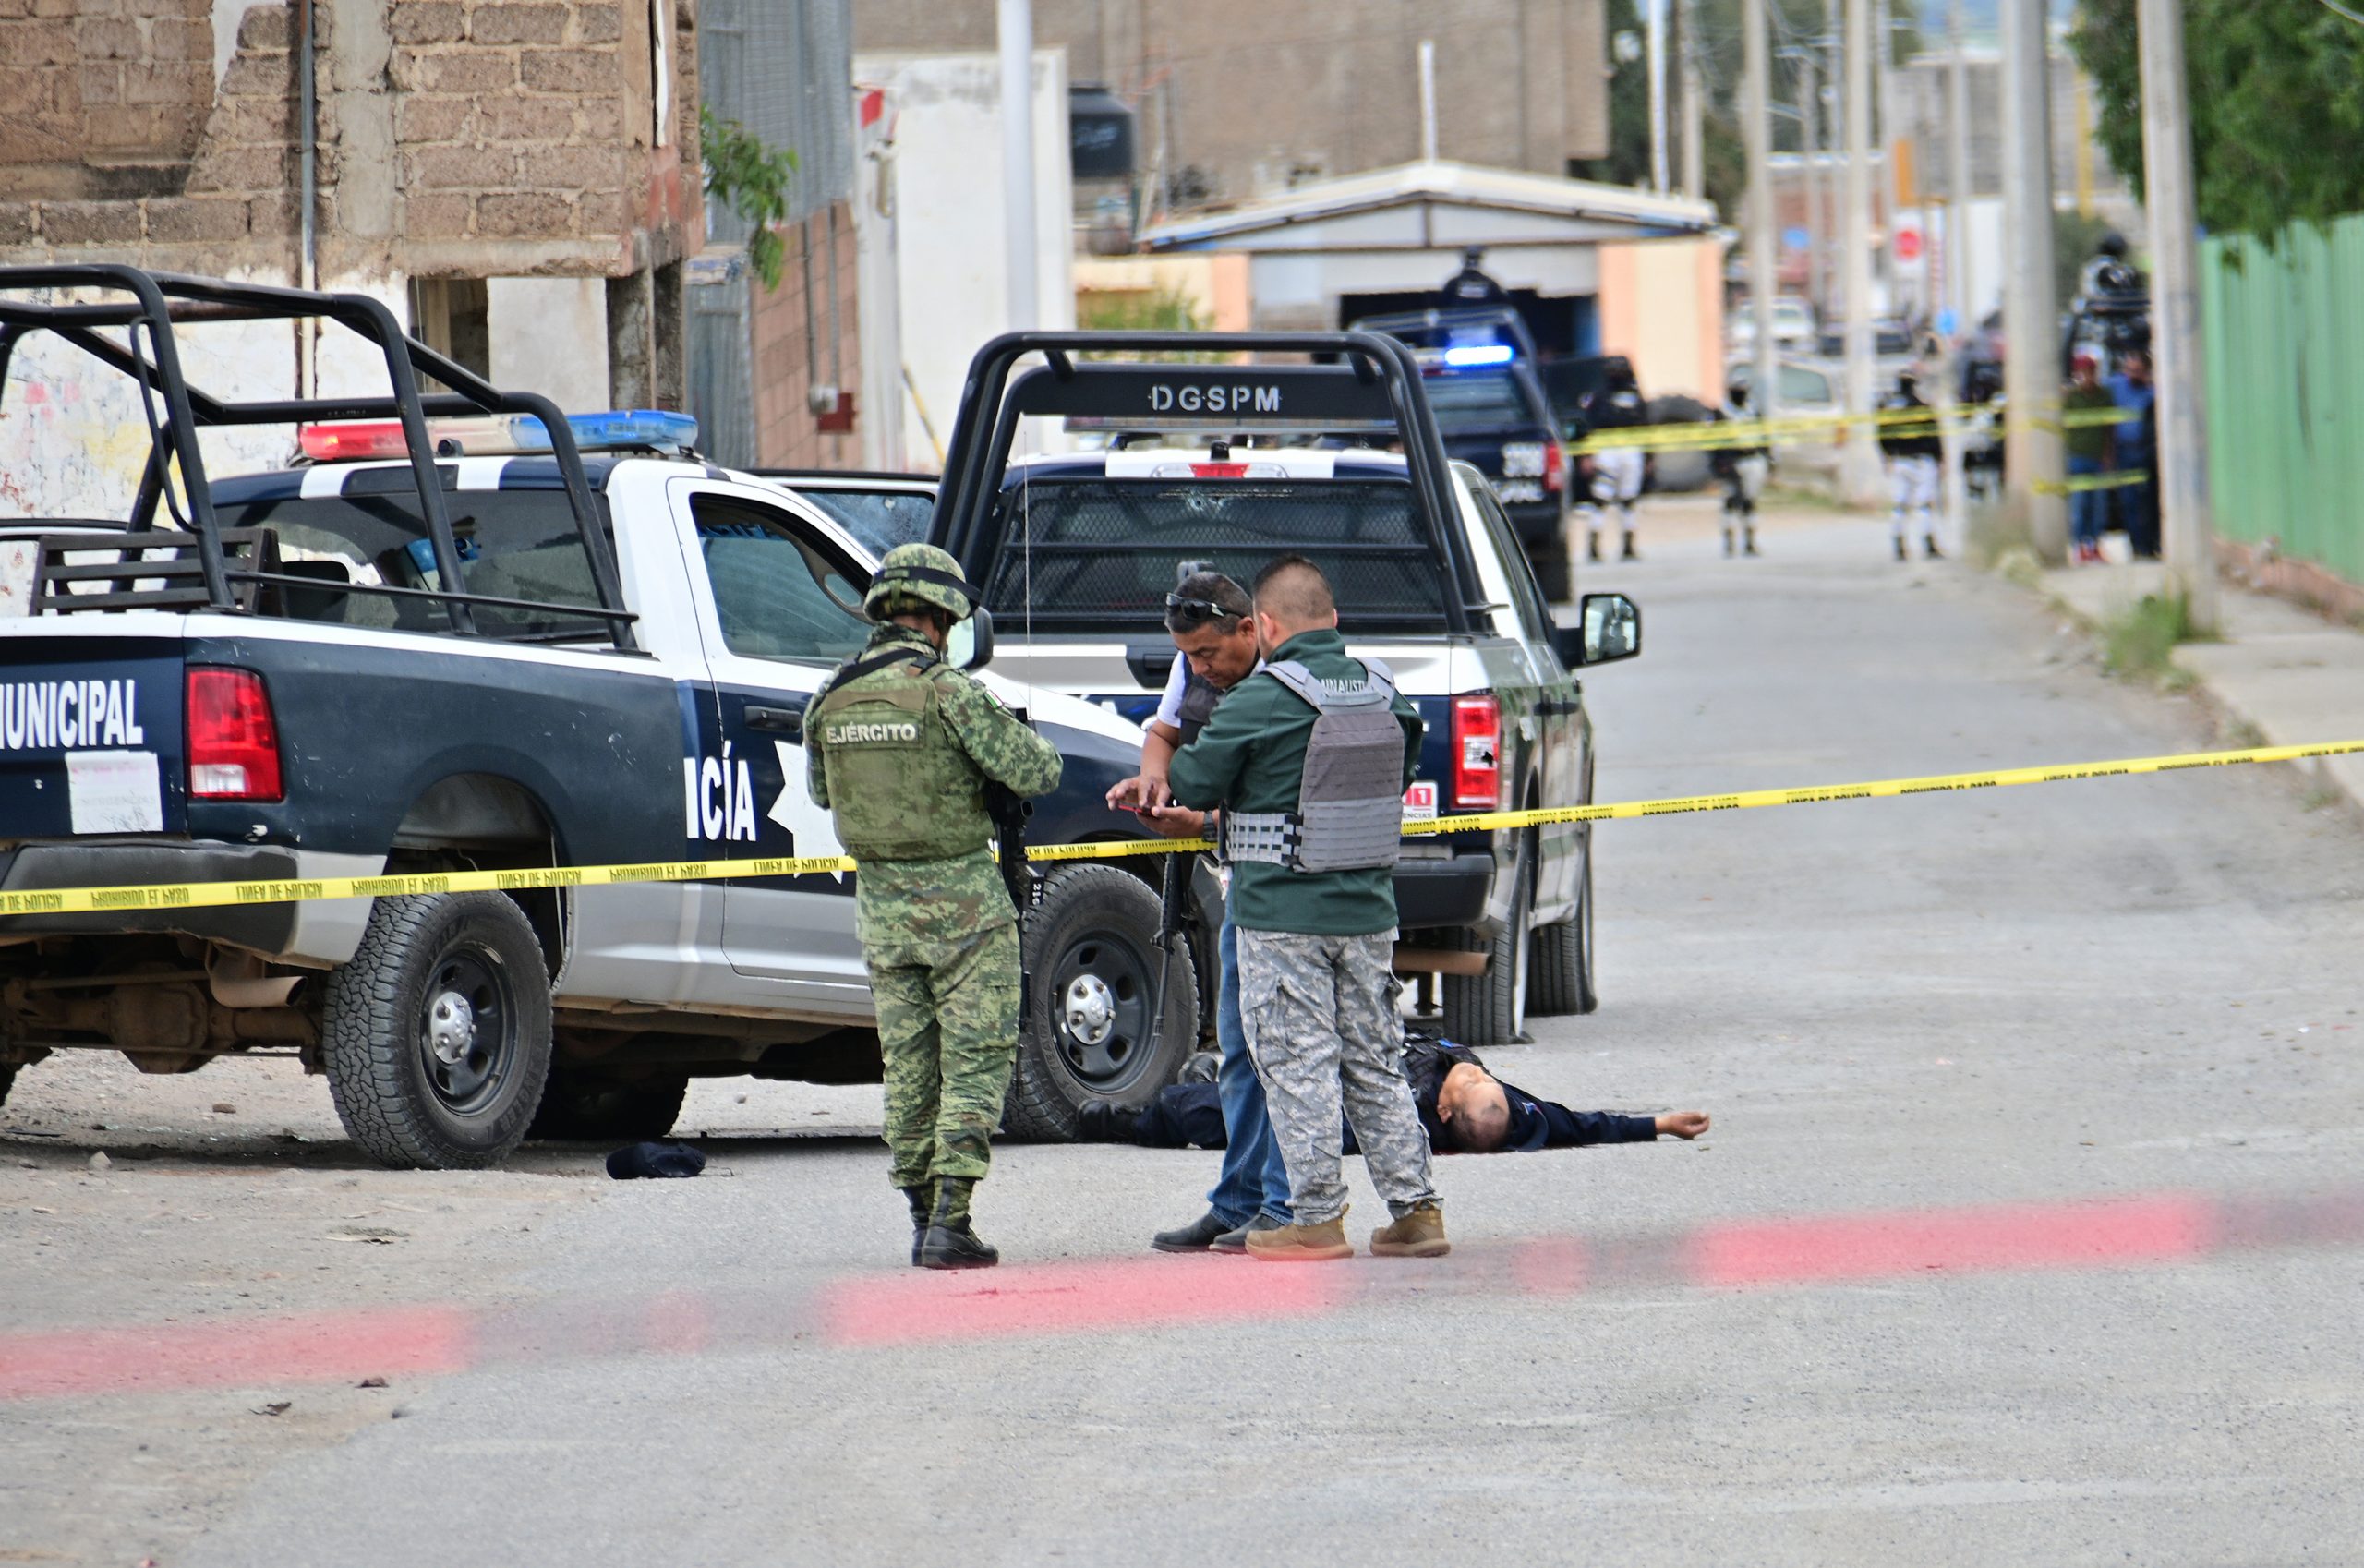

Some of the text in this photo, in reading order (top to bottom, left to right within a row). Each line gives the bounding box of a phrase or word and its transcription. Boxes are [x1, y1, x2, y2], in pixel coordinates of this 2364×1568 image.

[1152, 385, 1280, 412] DGSPM
[0, 679, 143, 750] UNICIPAL
[826, 720, 916, 744] EJÉRCITO
